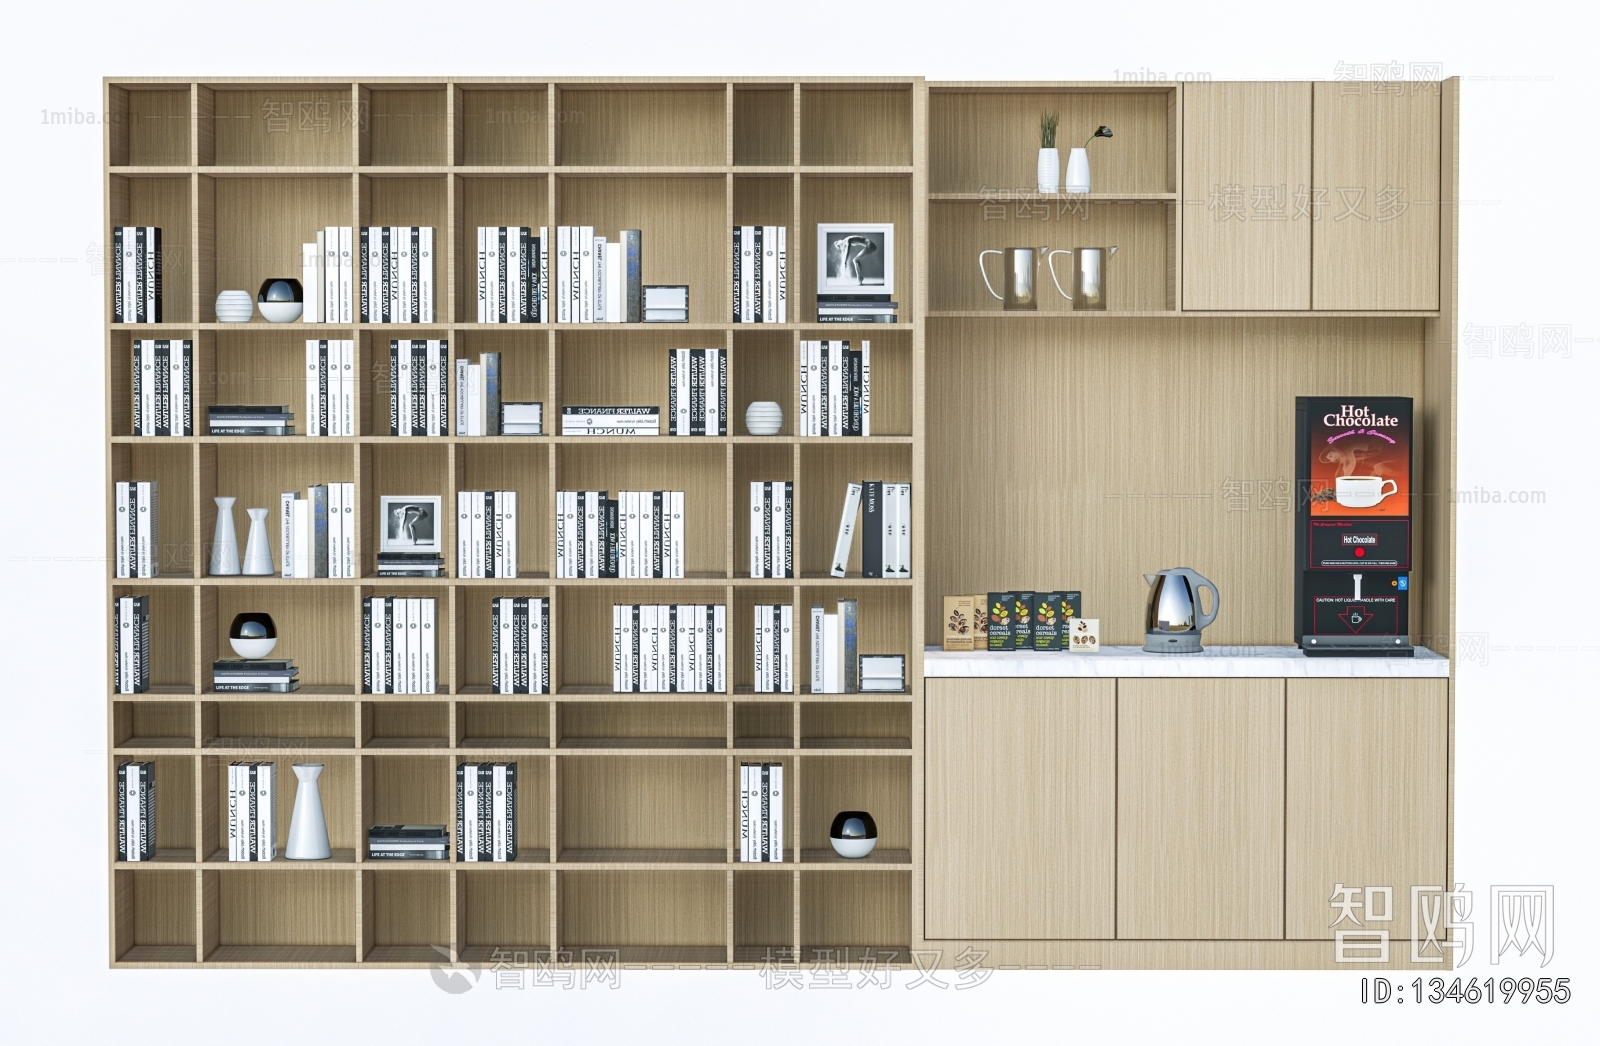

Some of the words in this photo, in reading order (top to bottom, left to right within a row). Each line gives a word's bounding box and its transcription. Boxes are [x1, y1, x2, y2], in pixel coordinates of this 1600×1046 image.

[1340, 404, 1370, 418] Hot
[1323, 414, 1398, 427] Chocolate
[1344, 536, 1352, 544] Hot
[1352, 536, 1376, 544] Chocolate
